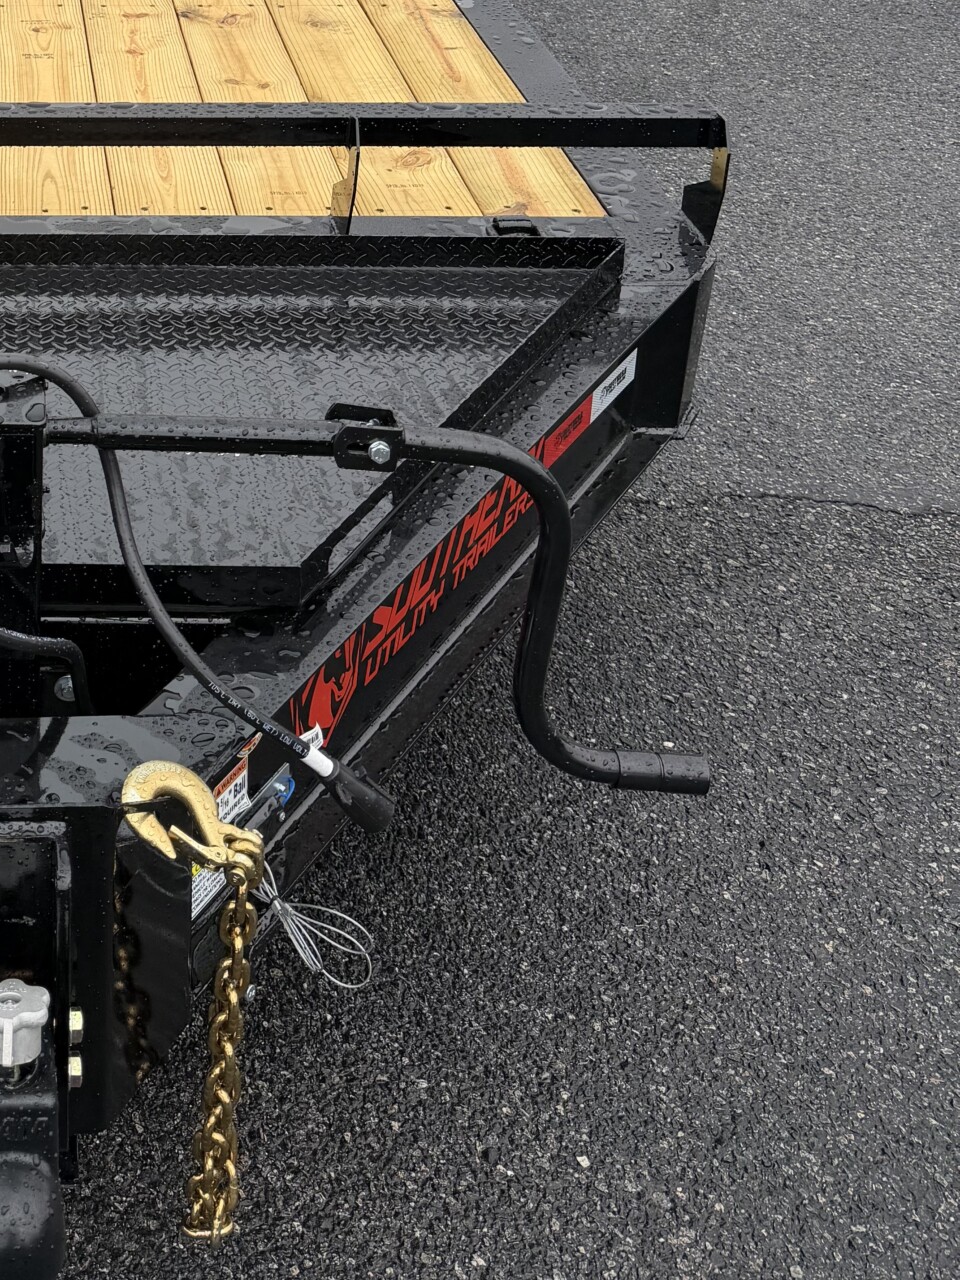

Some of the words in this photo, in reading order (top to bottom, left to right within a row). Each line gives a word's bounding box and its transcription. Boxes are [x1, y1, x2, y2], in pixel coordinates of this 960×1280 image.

[364, 578, 445, 686] UTILITY
[221, 760, 247, 790] WARNING
[234, 774, 246, 799] Ball
[220, 793, 246, 821] QUIRED
